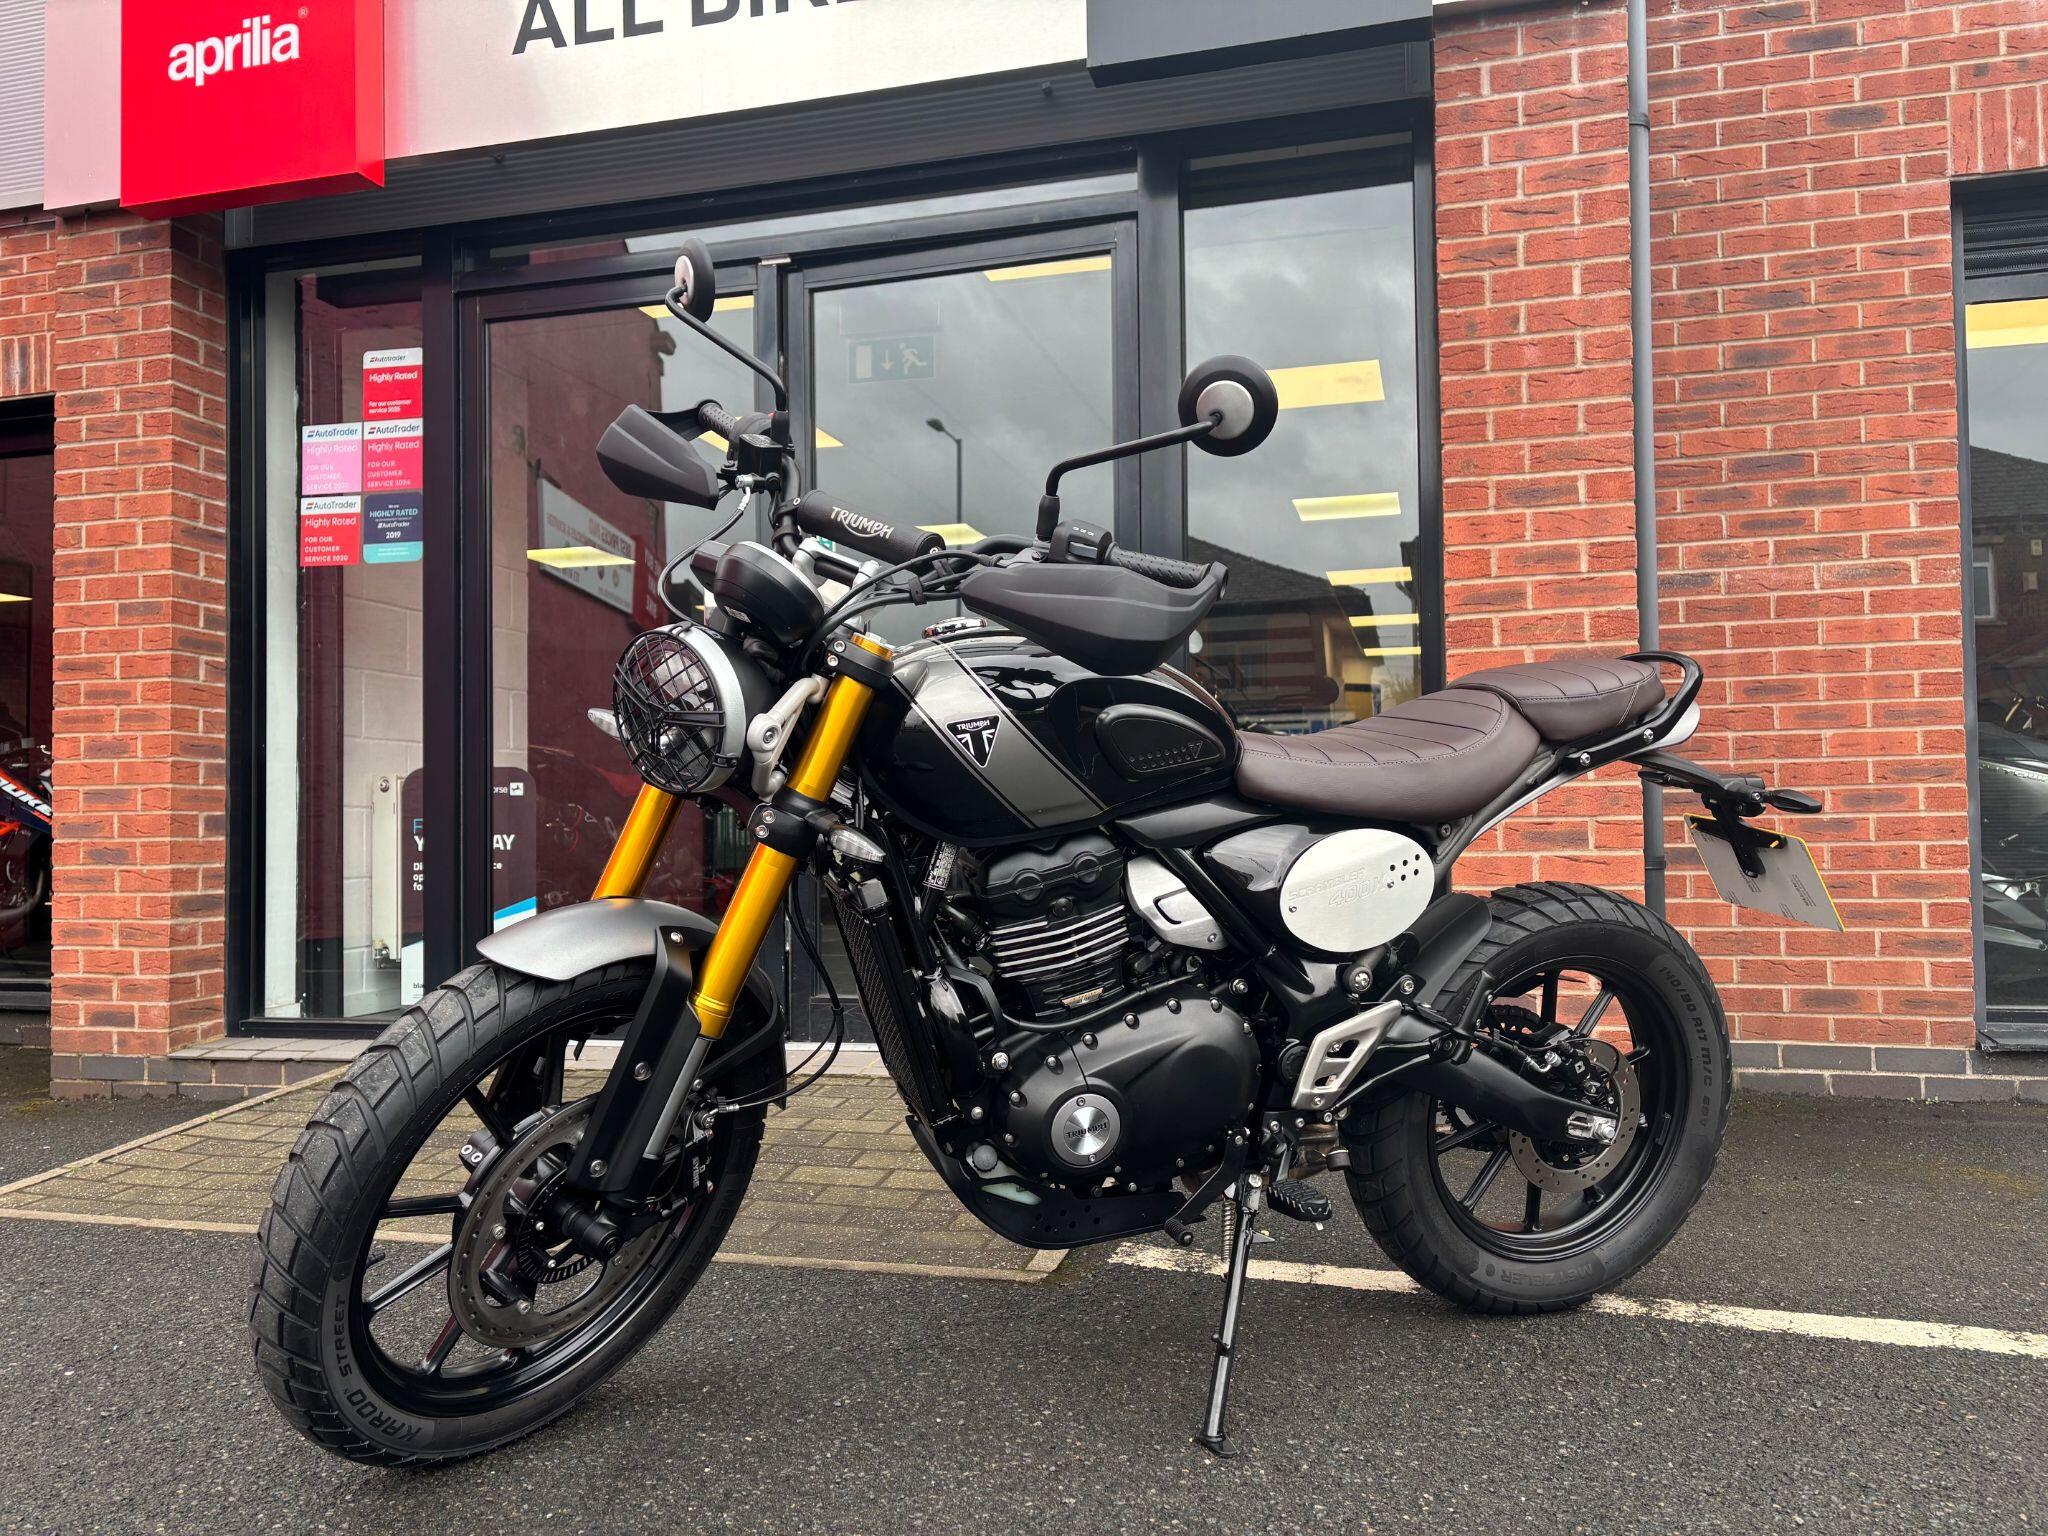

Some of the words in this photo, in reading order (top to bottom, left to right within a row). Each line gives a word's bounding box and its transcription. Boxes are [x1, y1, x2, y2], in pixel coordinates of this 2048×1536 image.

[512, 0, 663, 55] ALL
[168, 14, 300, 87] aprilia
[369, 372, 394, 384] Highly
[394, 370, 418, 380] Rated
[315, 428, 358, 438] AutoTrader
[376, 424, 420, 434] AutoTrader
[306, 445, 332, 457] Highly
[333, 443, 358, 454] Rated
[367, 442, 394, 454] Highly
[394, 440, 420, 450] Rated
[381, 460, 396, 468] OUR
[367, 469, 403, 478] CUSTOMER
[367, 480, 393, 488] SERVICE
[314, 500, 357, 510] AutoTrader
[369, 510, 394, 518] HIGHLY
[395, 508, 418, 516] RATED
[305, 517, 331, 529] Highly
[332, 517, 357, 527] Rated
[382, 521, 410, 529] AutoTrader
[831, 506, 895, 539] TRIUMPH
[319, 535, 333, 543] OUR
[385, 531, 402, 539] 2019
[304, 545, 341, 553] CUSTOMER
[304, 555, 332, 563] SERVICE
[956, 720, 990, 731] TRIUMPH
[0, 777, 52, 817] UKE
[1066, 1122, 1108, 1138] TRIUMPH
[1501, 1263, 1593, 1287] METZELER
[334, 1295, 352, 1378] STREET
[346, 1388, 422, 1442] KAROO
